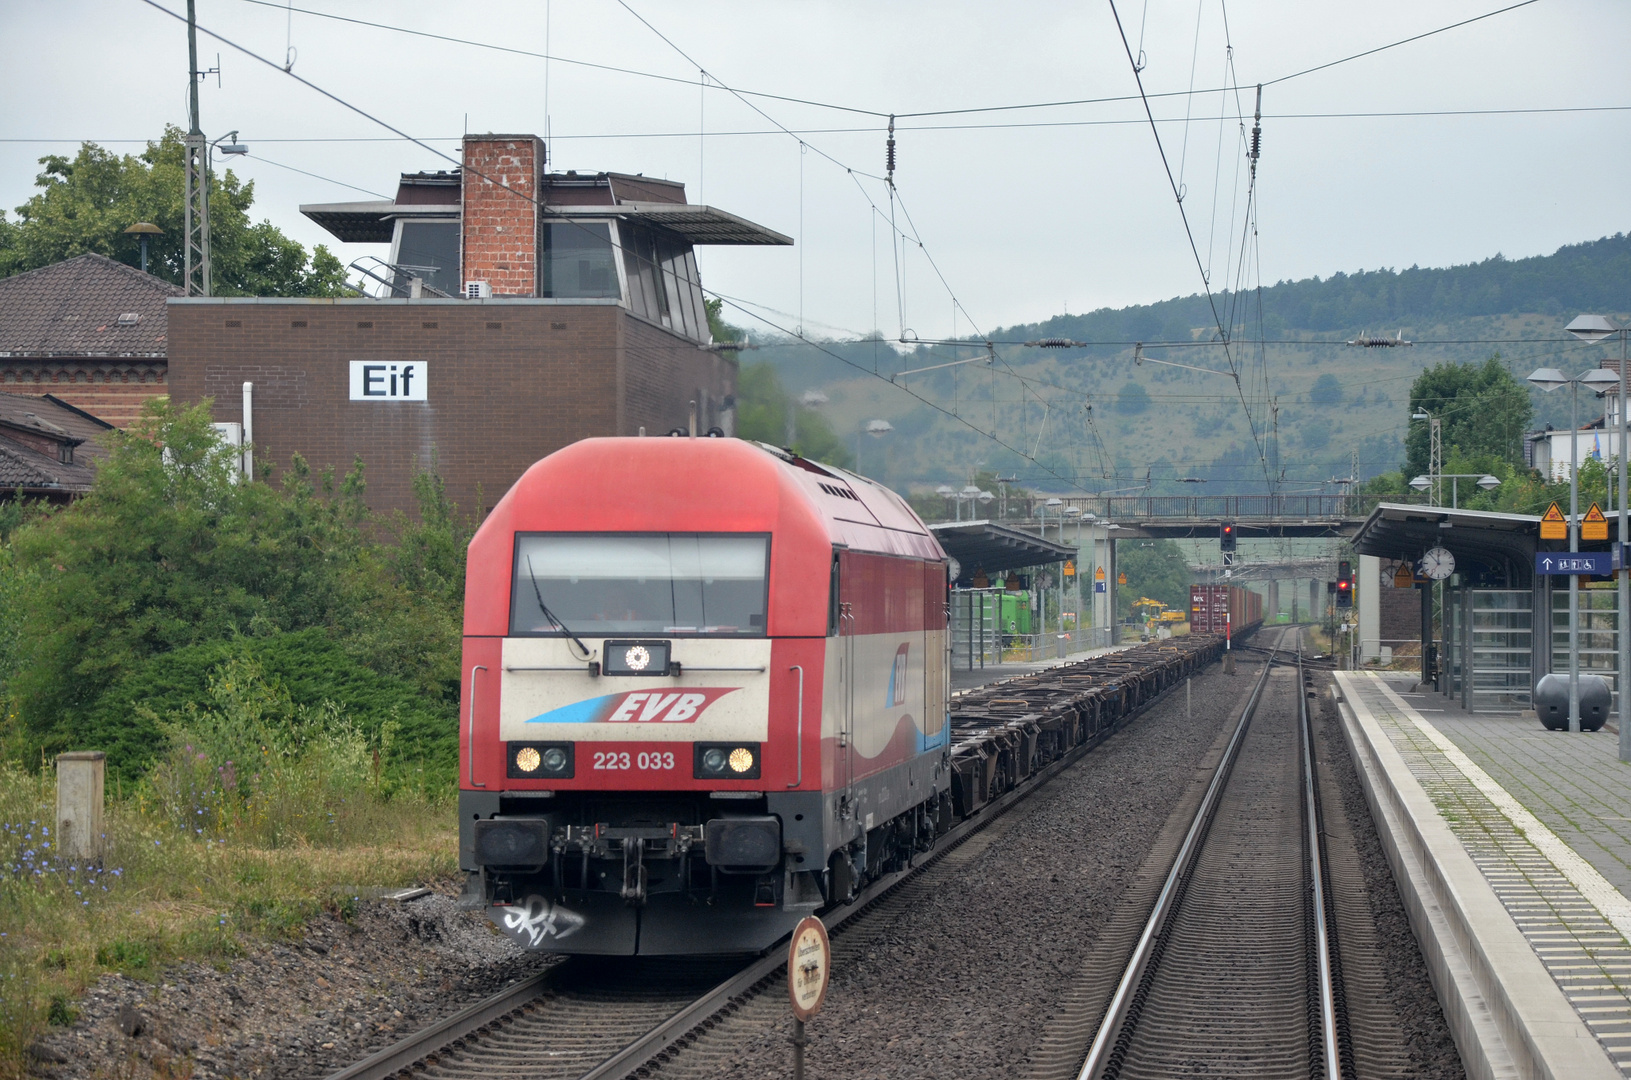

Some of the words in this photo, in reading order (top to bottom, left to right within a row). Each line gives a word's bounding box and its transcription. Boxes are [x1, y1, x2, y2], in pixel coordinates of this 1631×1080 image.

[363, 365, 414, 396] Eif
[608, 692, 706, 722] EVB
[593, 751, 631, 770] 223
[637, 751, 675, 770] 033
